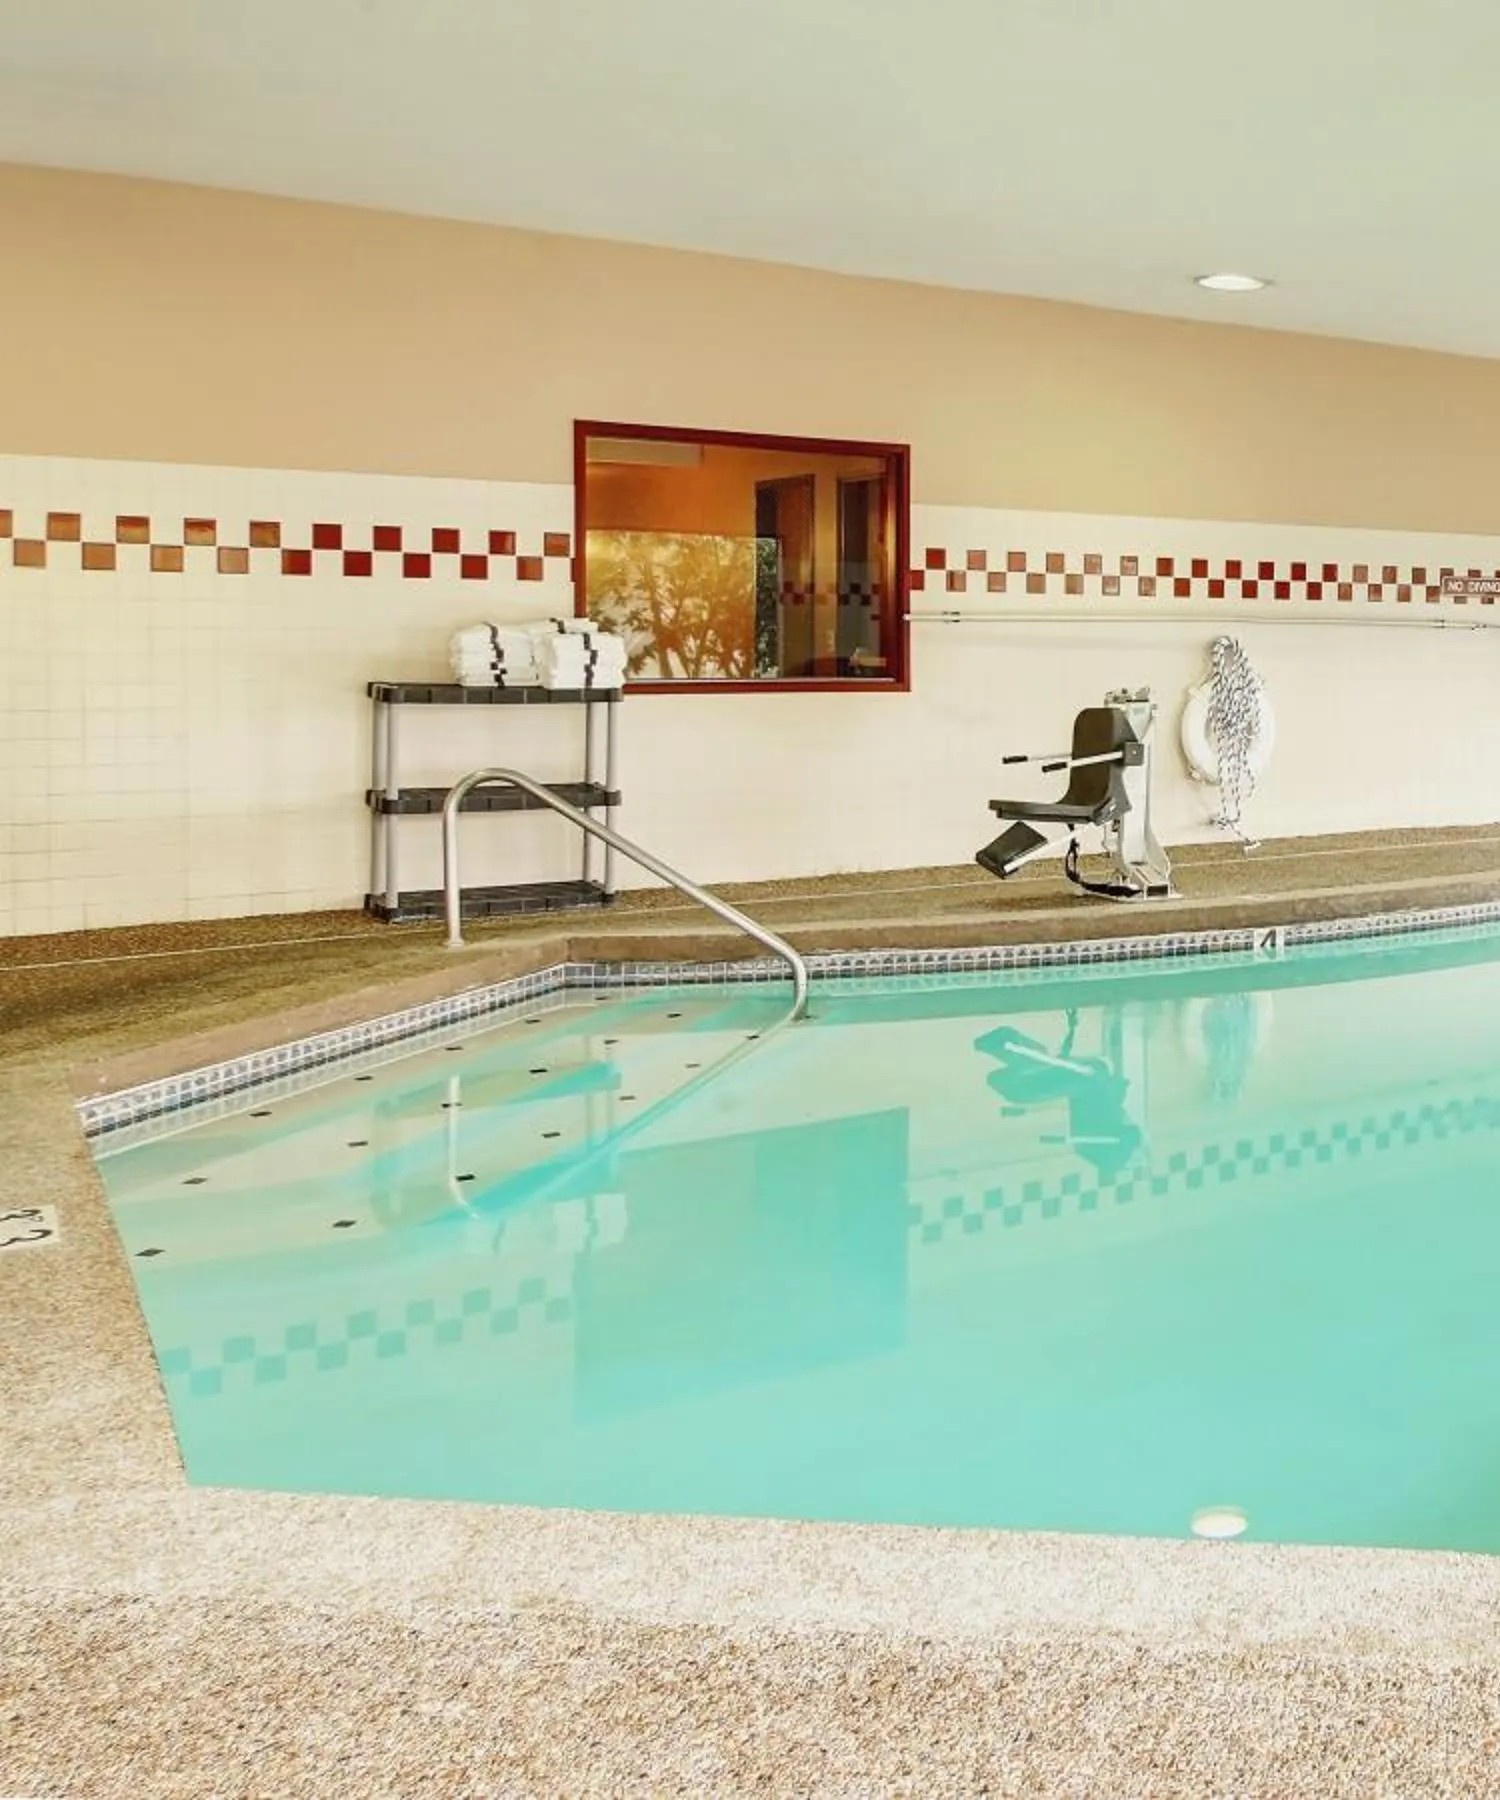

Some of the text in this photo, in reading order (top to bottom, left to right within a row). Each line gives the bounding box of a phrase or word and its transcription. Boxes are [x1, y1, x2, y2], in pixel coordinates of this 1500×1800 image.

[1447, 581, 1500, 592] NO DIVING
[1260, 929, 1277, 948] 4
